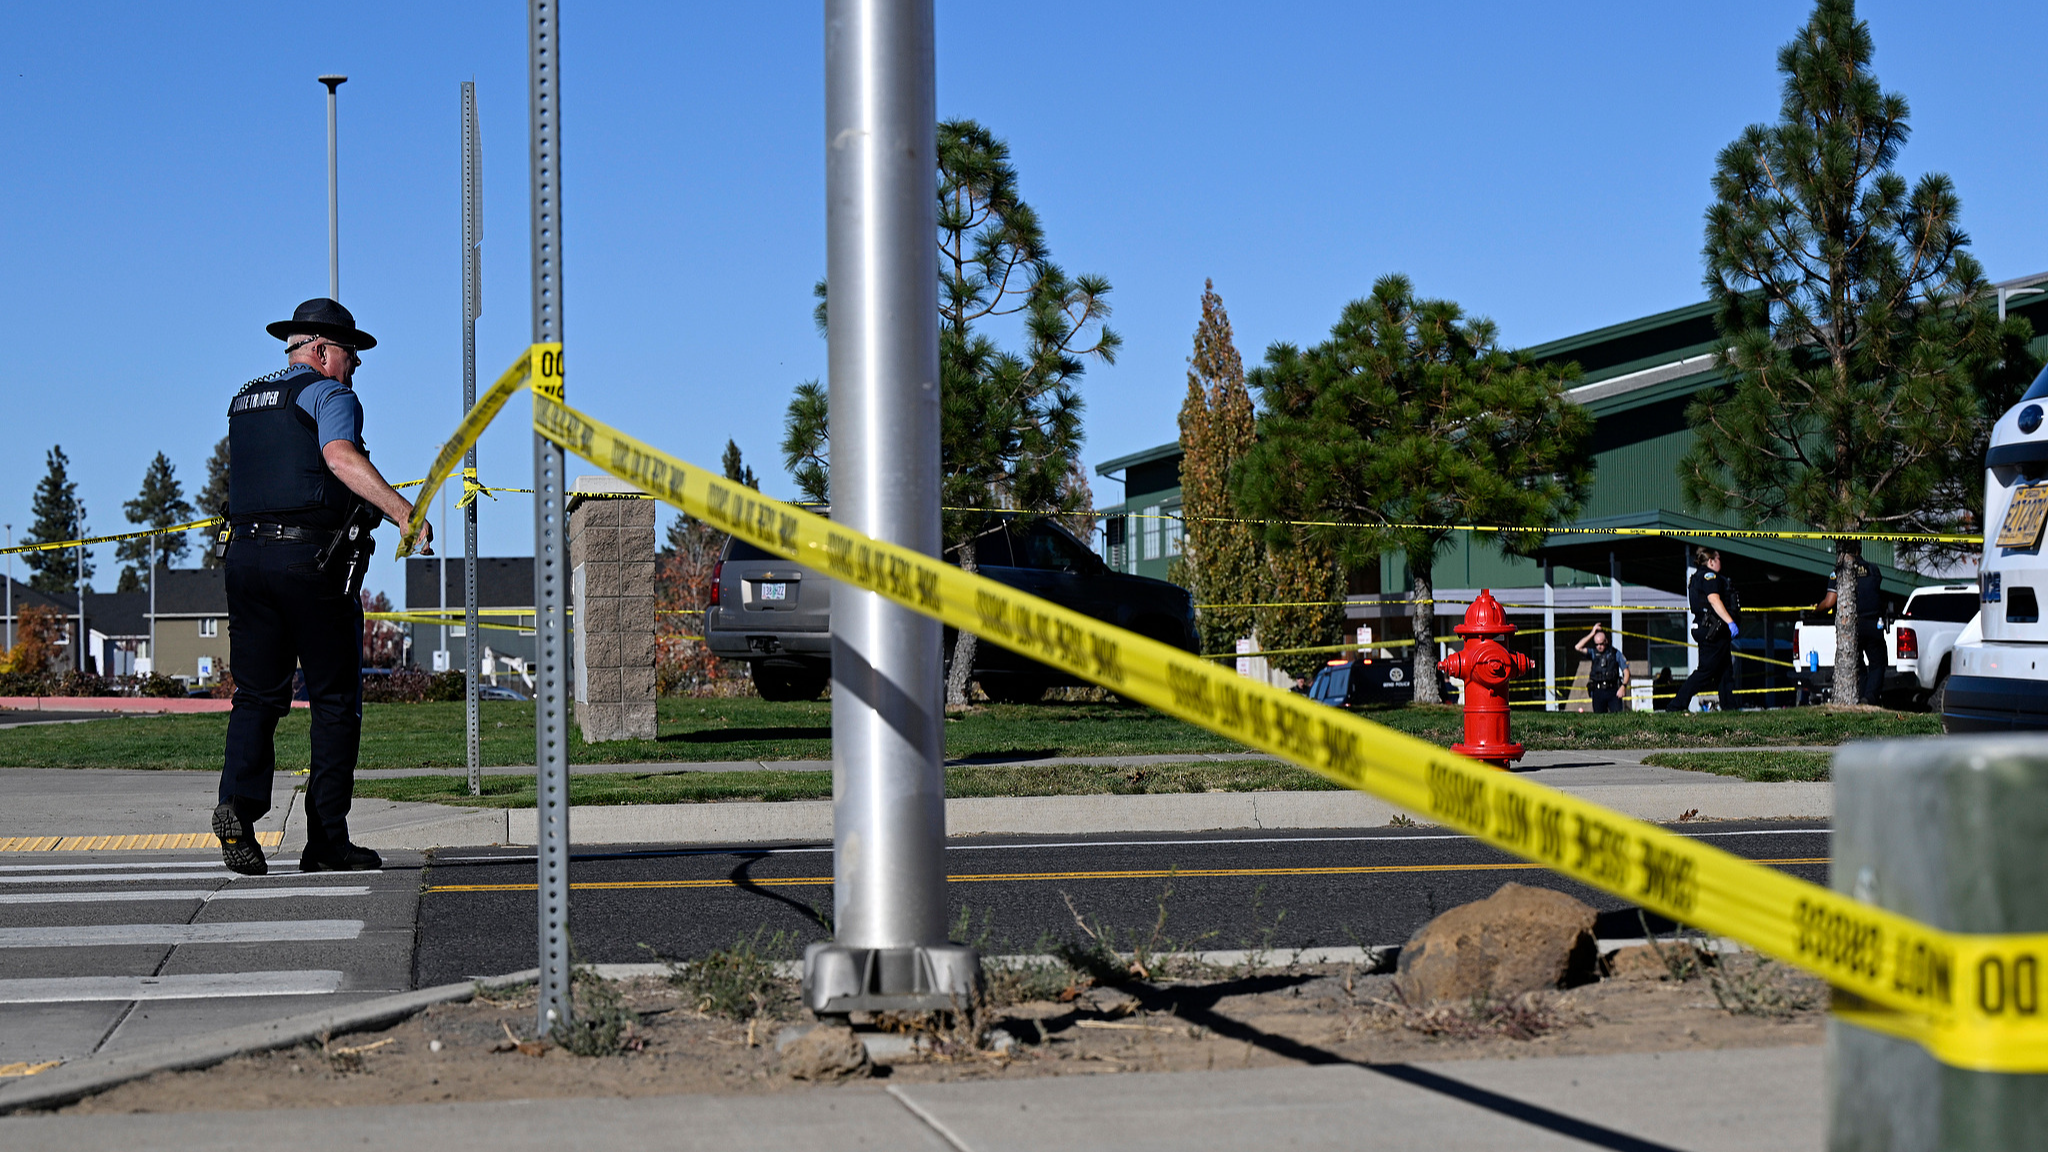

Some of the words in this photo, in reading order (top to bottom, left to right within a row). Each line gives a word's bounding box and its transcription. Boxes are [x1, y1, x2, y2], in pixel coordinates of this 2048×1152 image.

[234, 395, 250, 412] STATE
[249, 391, 279, 408] TROOPER
[1794, 898, 1884, 978] CROSS
[1893, 936, 1953, 1007] NOT
[1978, 954, 2037, 1016] DO
